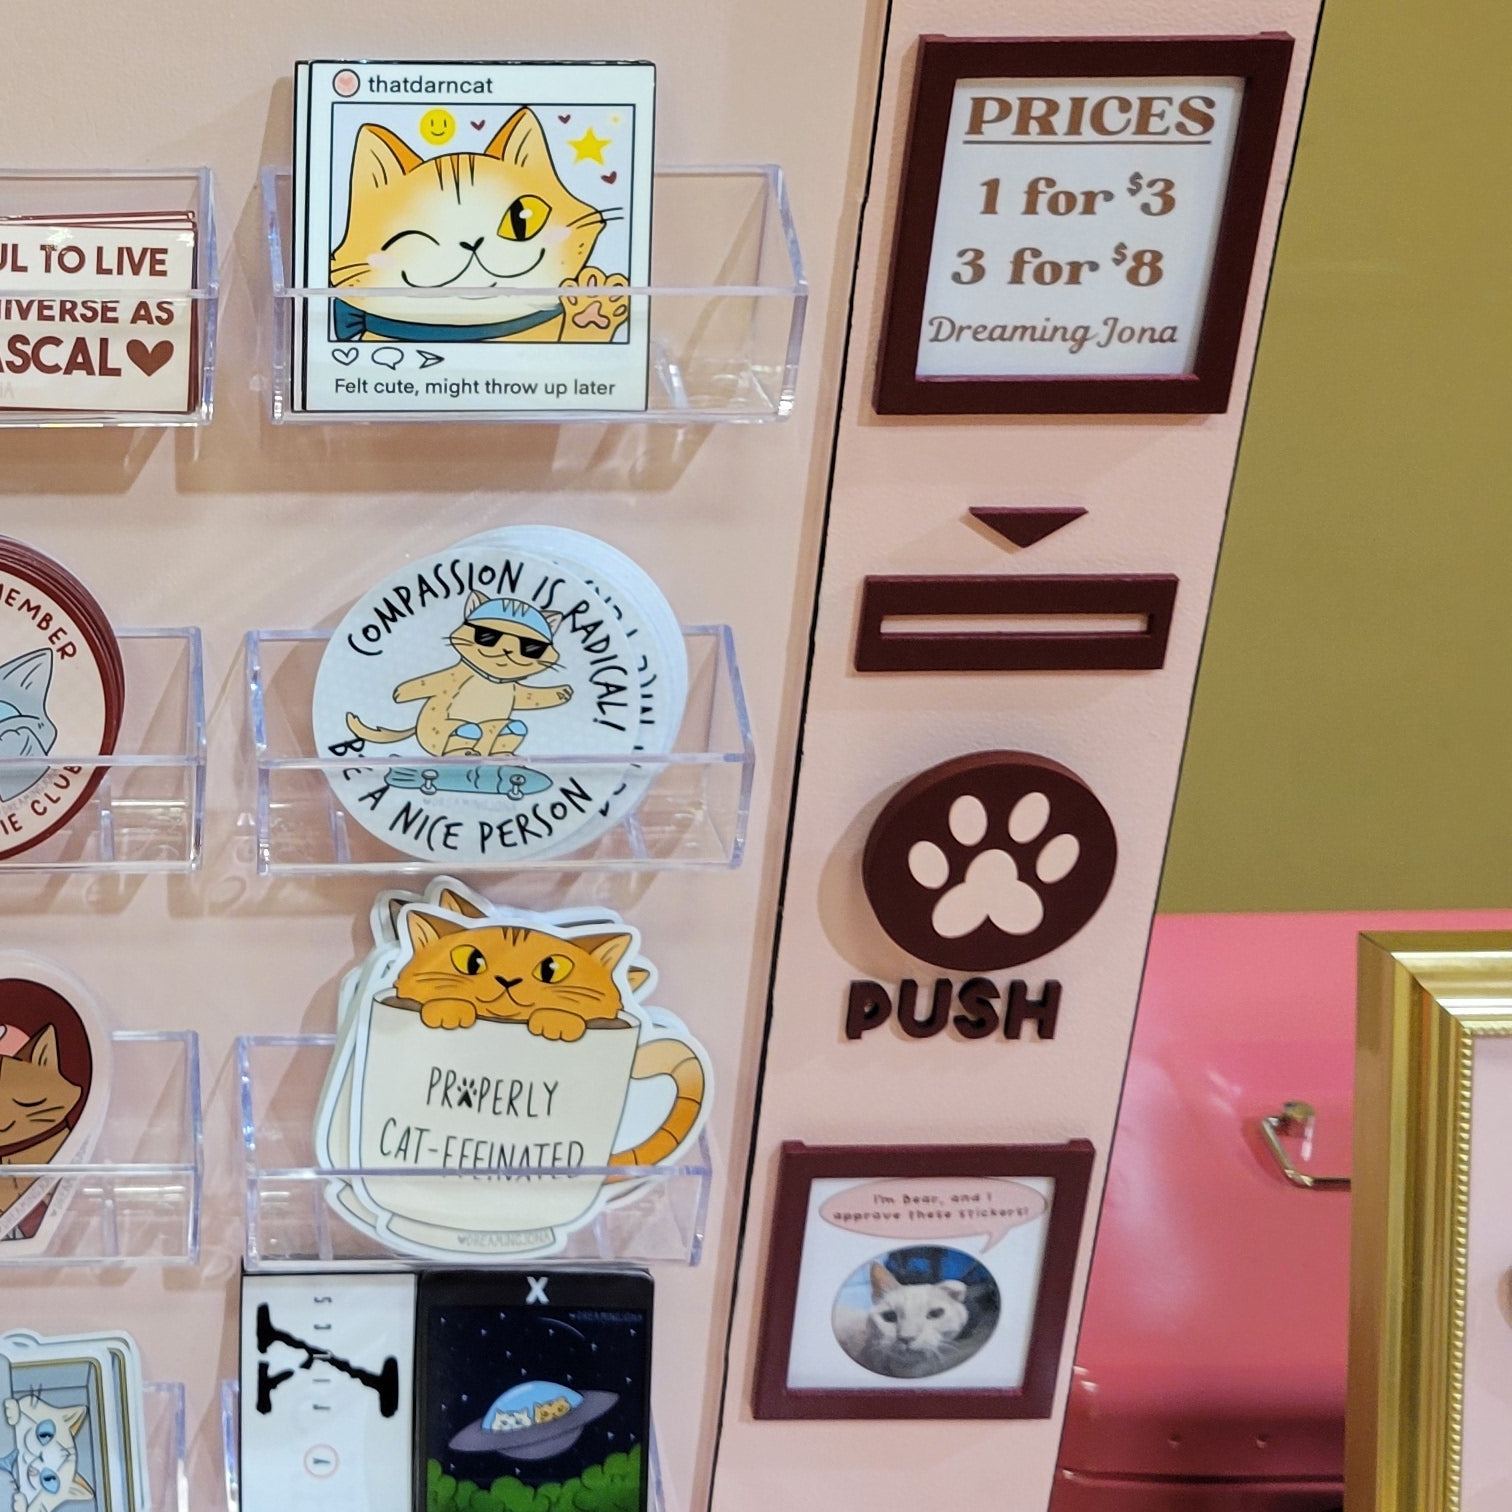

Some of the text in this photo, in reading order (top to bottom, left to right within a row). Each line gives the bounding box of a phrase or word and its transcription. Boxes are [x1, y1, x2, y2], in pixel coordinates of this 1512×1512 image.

[368, 75, 494, 95] thatdarncat
[963, 95, 1217, 137] PRICES
[980, 171, 1177, 217] 1 for $3
[40, 245, 86, 274] TO
[96, 247, 169, 277] LIVE
[951, 242, 1164, 287] 3 for $8
[130, 299, 175, 326] AS
[928, 316, 1179, 354] Dreaming Jona
[334, 378, 616, 399] Felt cute, might throw up later
[348, 559, 524, 656] COMPASSION
[532, 576, 566, 609] IS
[562, 600, 628, 731] RADICAL!
[358, 784, 390, 811] A
[389, 801, 464, 851] NICE
[479, 777, 593, 854] PERSON
[845, 976, 1063, 1041] PUSH
[525, 1276, 551, 1305] X
